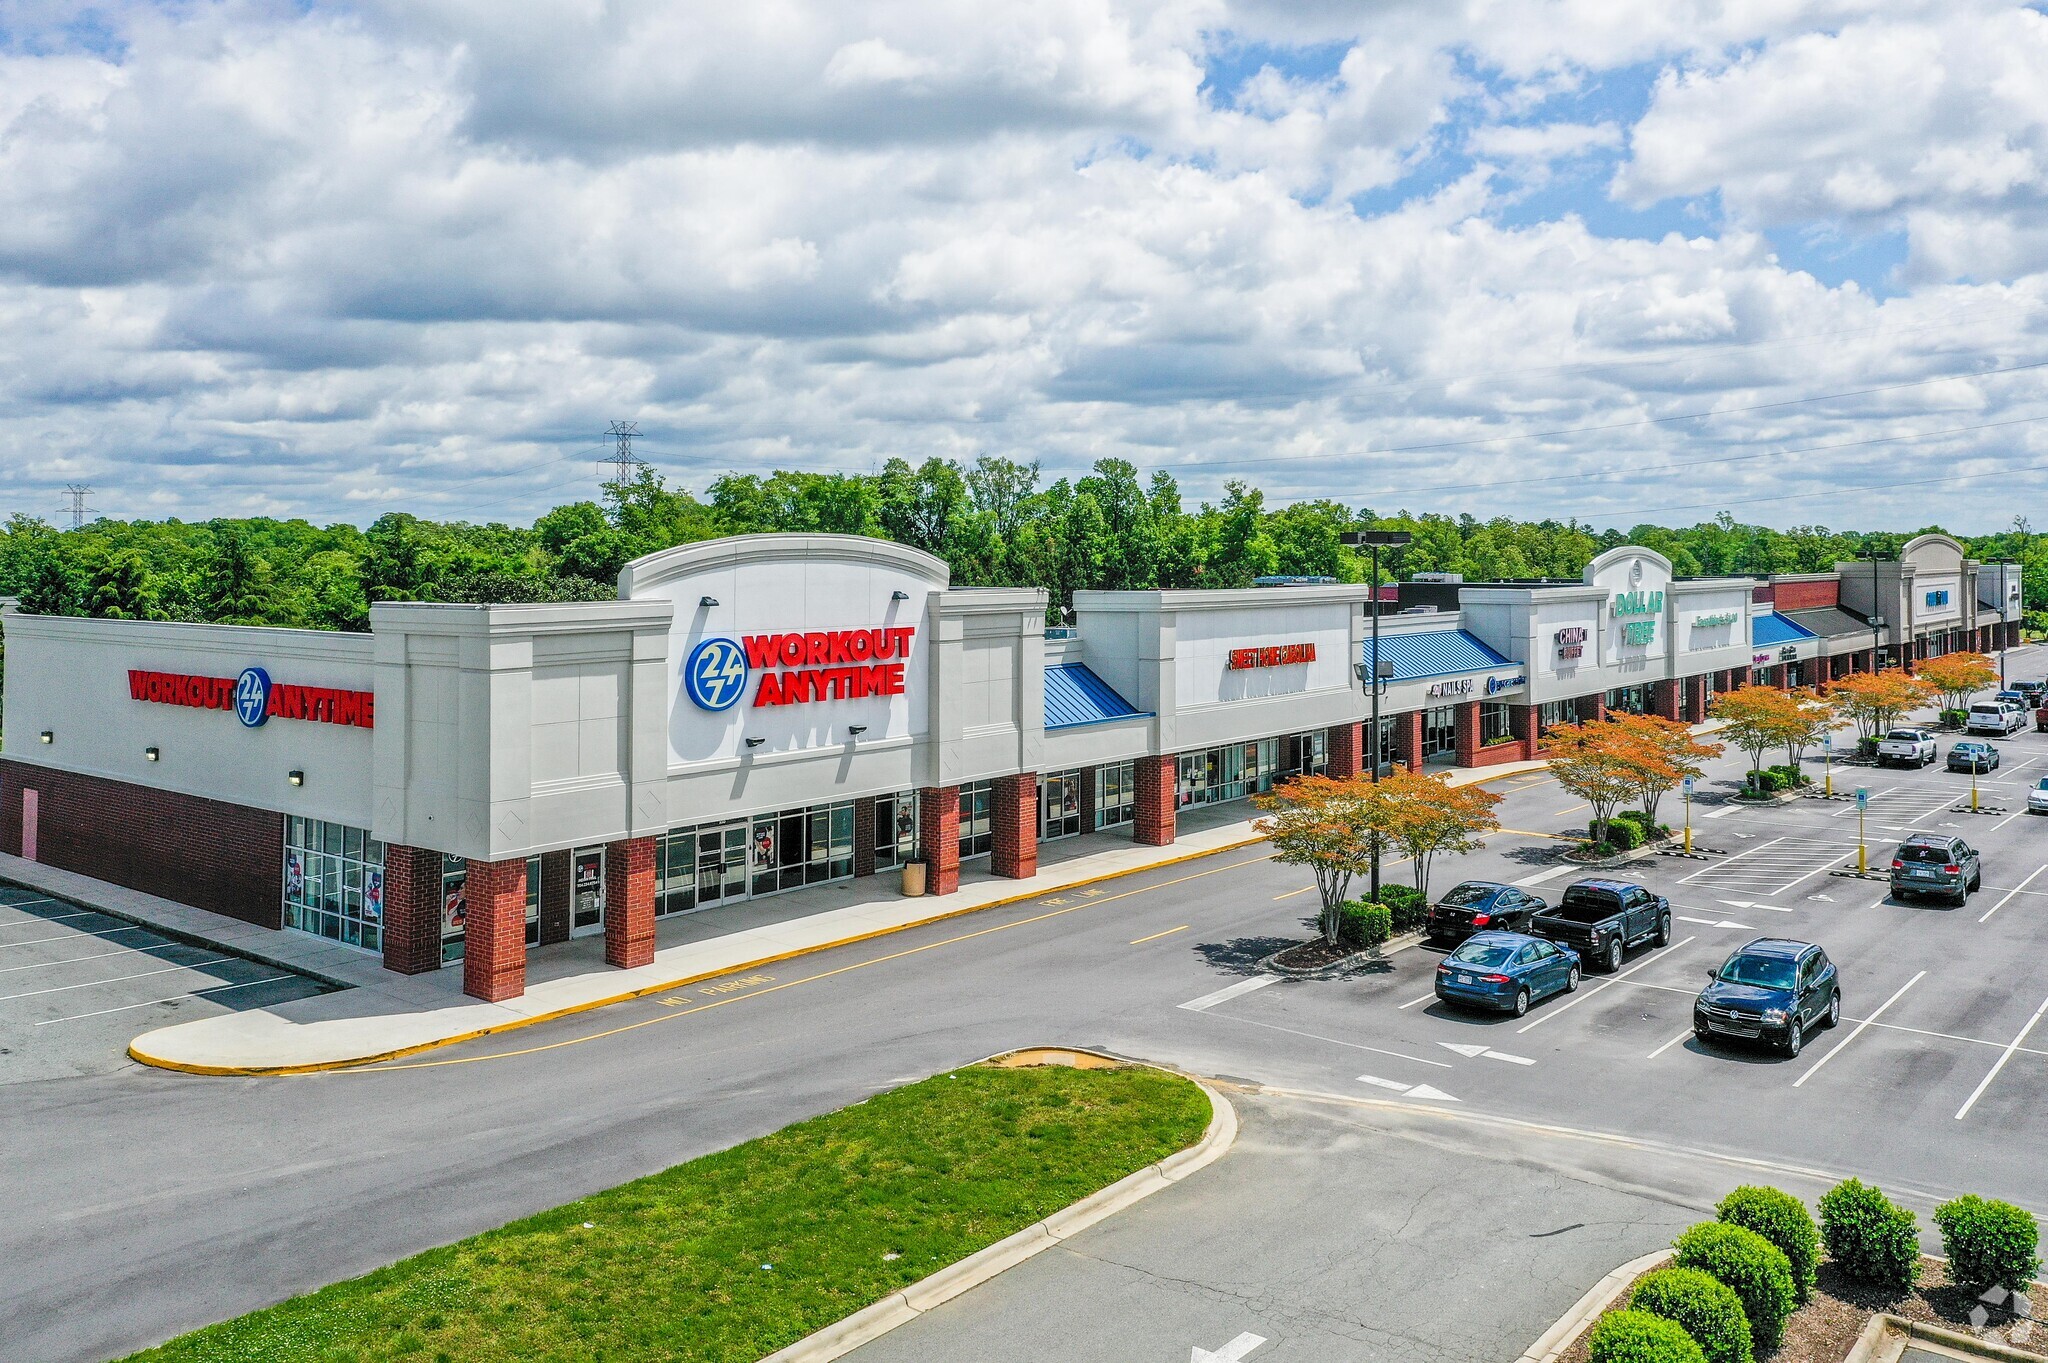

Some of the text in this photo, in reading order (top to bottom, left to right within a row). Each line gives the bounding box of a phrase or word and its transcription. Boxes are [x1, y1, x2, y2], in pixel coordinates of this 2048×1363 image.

[1615, 591, 1664, 617] DOLLAR
[1559, 626, 1584, 645] CHINA
[1626, 620, 1656, 646] TREE
[741, 627, 915, 671] WORKOUT
[1229, 648, 1258, 670] SWEET
[1258, 646, 1280, 668] HOME
[128, 670, 234, 711] WORKOUT
[753, 663, 905, 708] ANYTIME
[1441, 681, 1462, 697] NAILS
[266, 683, 374, 729] ANYTIME
[697, 974, 776, 996] PARKING
